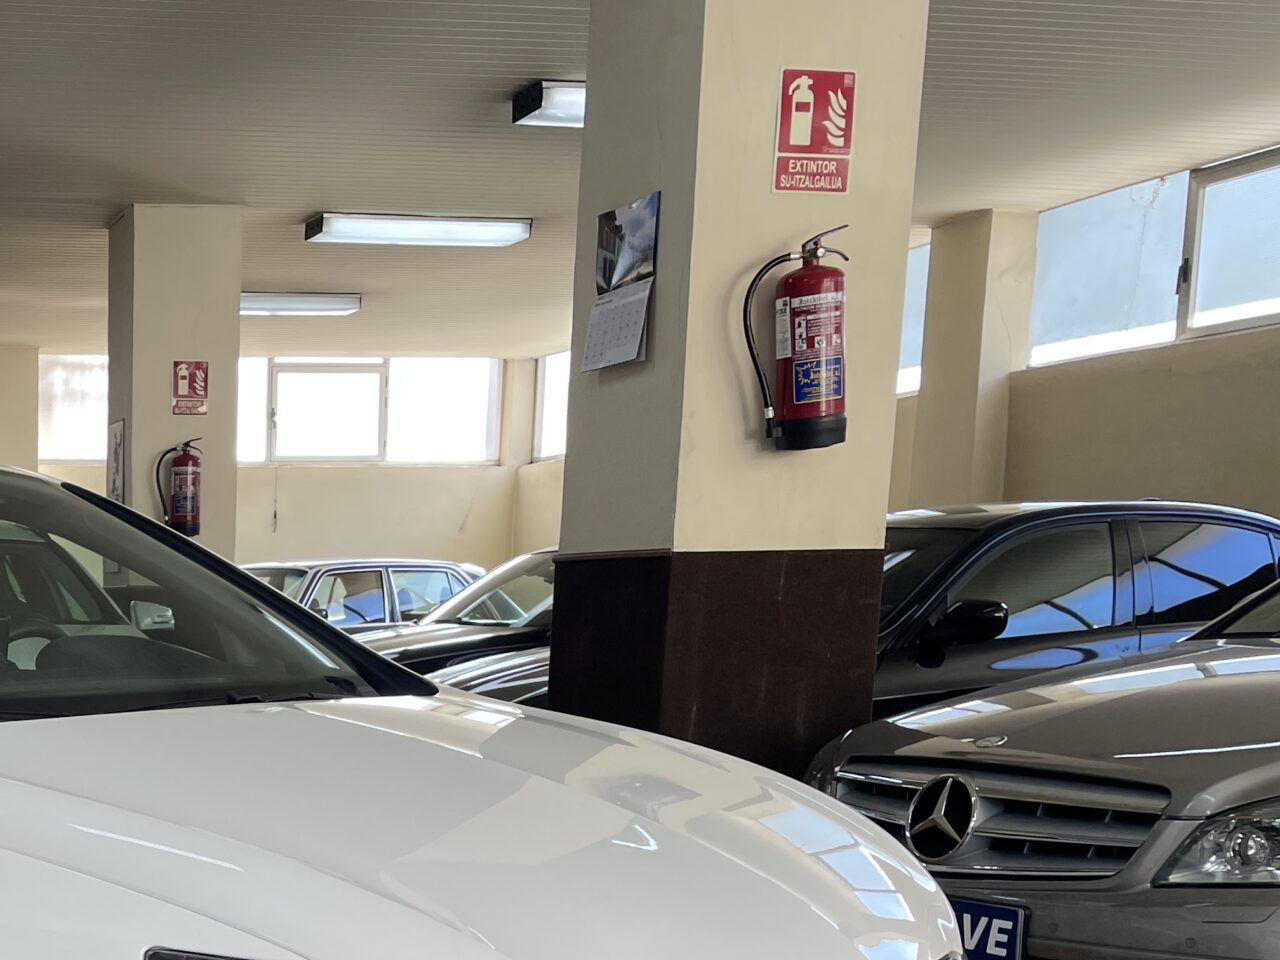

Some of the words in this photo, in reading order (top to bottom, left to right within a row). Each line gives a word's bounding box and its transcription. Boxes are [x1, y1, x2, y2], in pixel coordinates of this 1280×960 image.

[788, 159, 837, 174] EXTINTOR
[780, 174, 843, 189] SU-ITZALGAILUA
[963, 913, 1013, 957] VE
